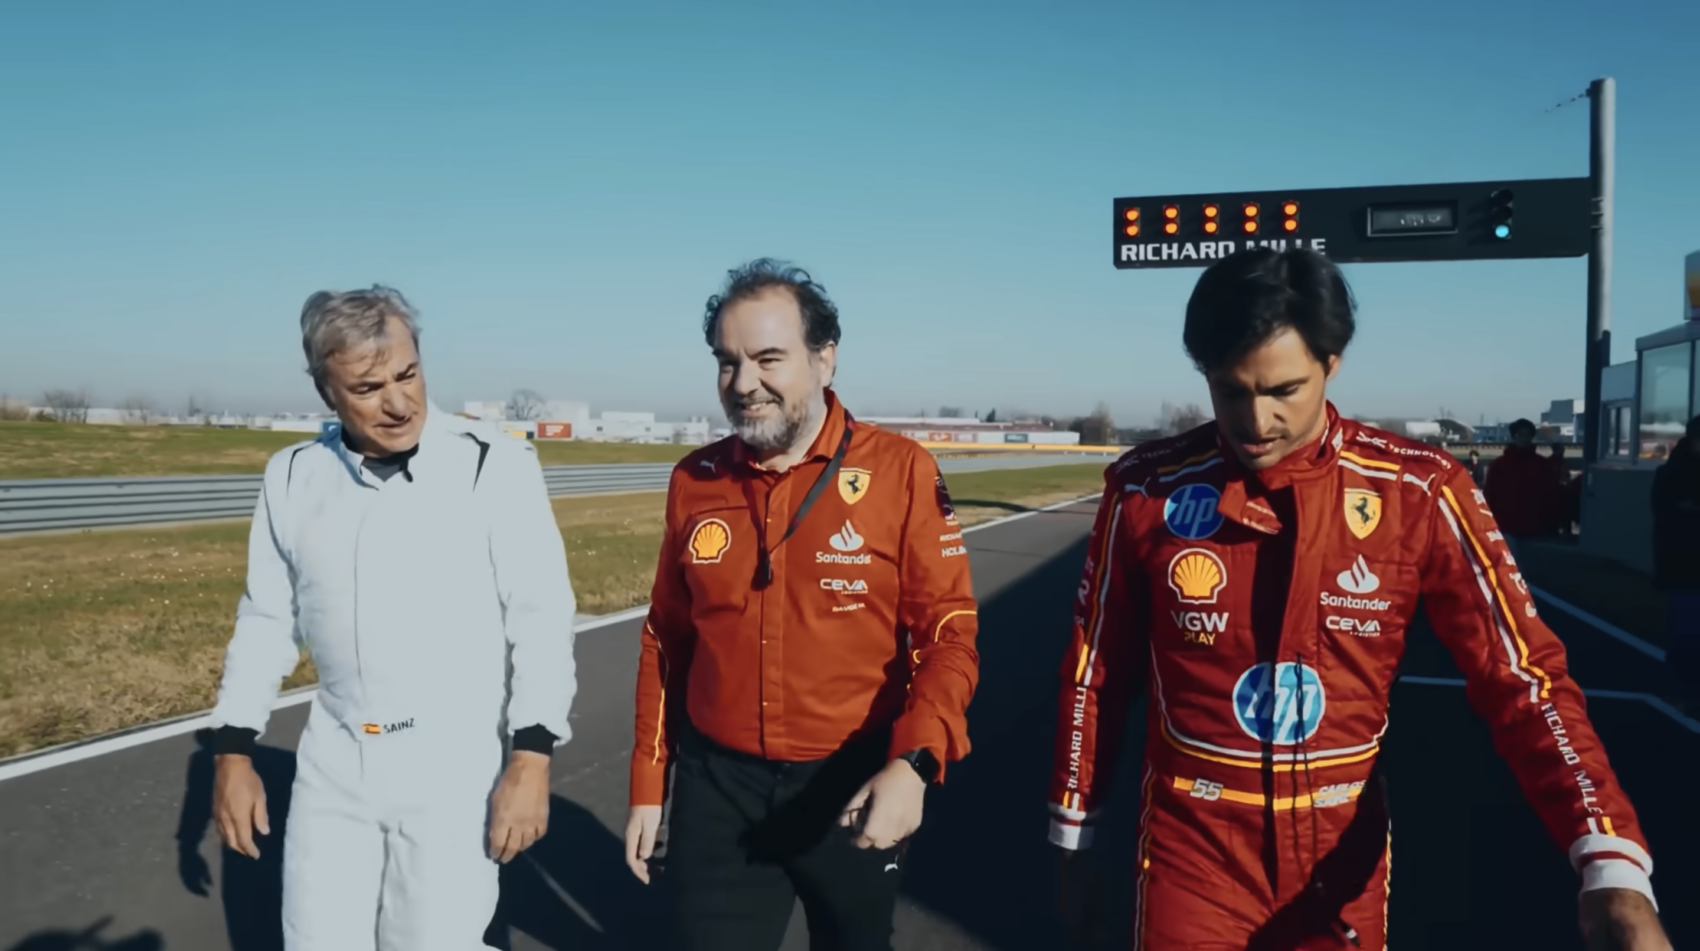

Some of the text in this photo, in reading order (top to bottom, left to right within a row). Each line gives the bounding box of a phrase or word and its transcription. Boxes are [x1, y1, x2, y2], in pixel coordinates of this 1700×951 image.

[1121, 241, 1235, 261] RICHARD
[1173, 486, 1217, 539] hp
[1320, 591, 1391, 610] Santander
[1170, 610, 1229, 632] VGW
[1184, 631, 1215, 645] PLAY
[383, 717, 415, 733] SAINZ
[1067, 731, 1083, 790] RICHARD
[1190, 778, 1222, 801] 55
[1574, 770, 1604, 815] MILLE
